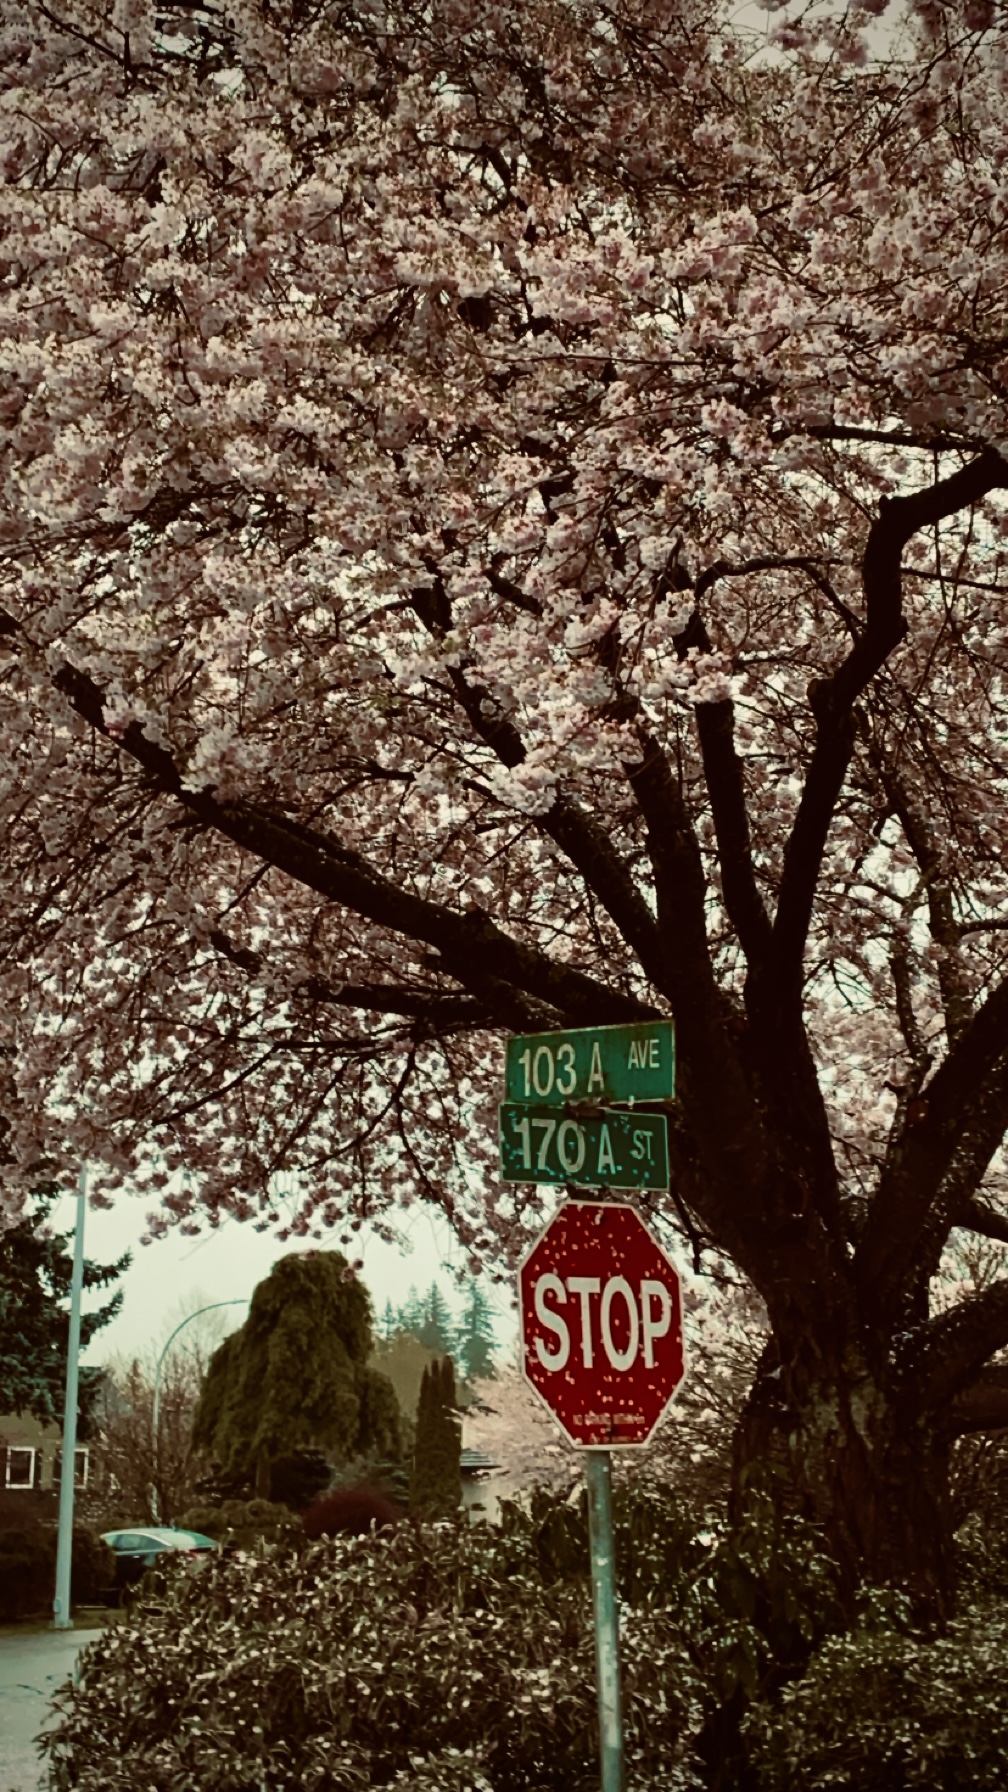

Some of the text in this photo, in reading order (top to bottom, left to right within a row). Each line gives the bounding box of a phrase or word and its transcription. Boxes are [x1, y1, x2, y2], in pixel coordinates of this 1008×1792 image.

[518, 1039, 660, 1097] 103 A AVE
[513, 1117, 654, 1175] 170 A ST
[534, 1272, 673, 1372] STOP
